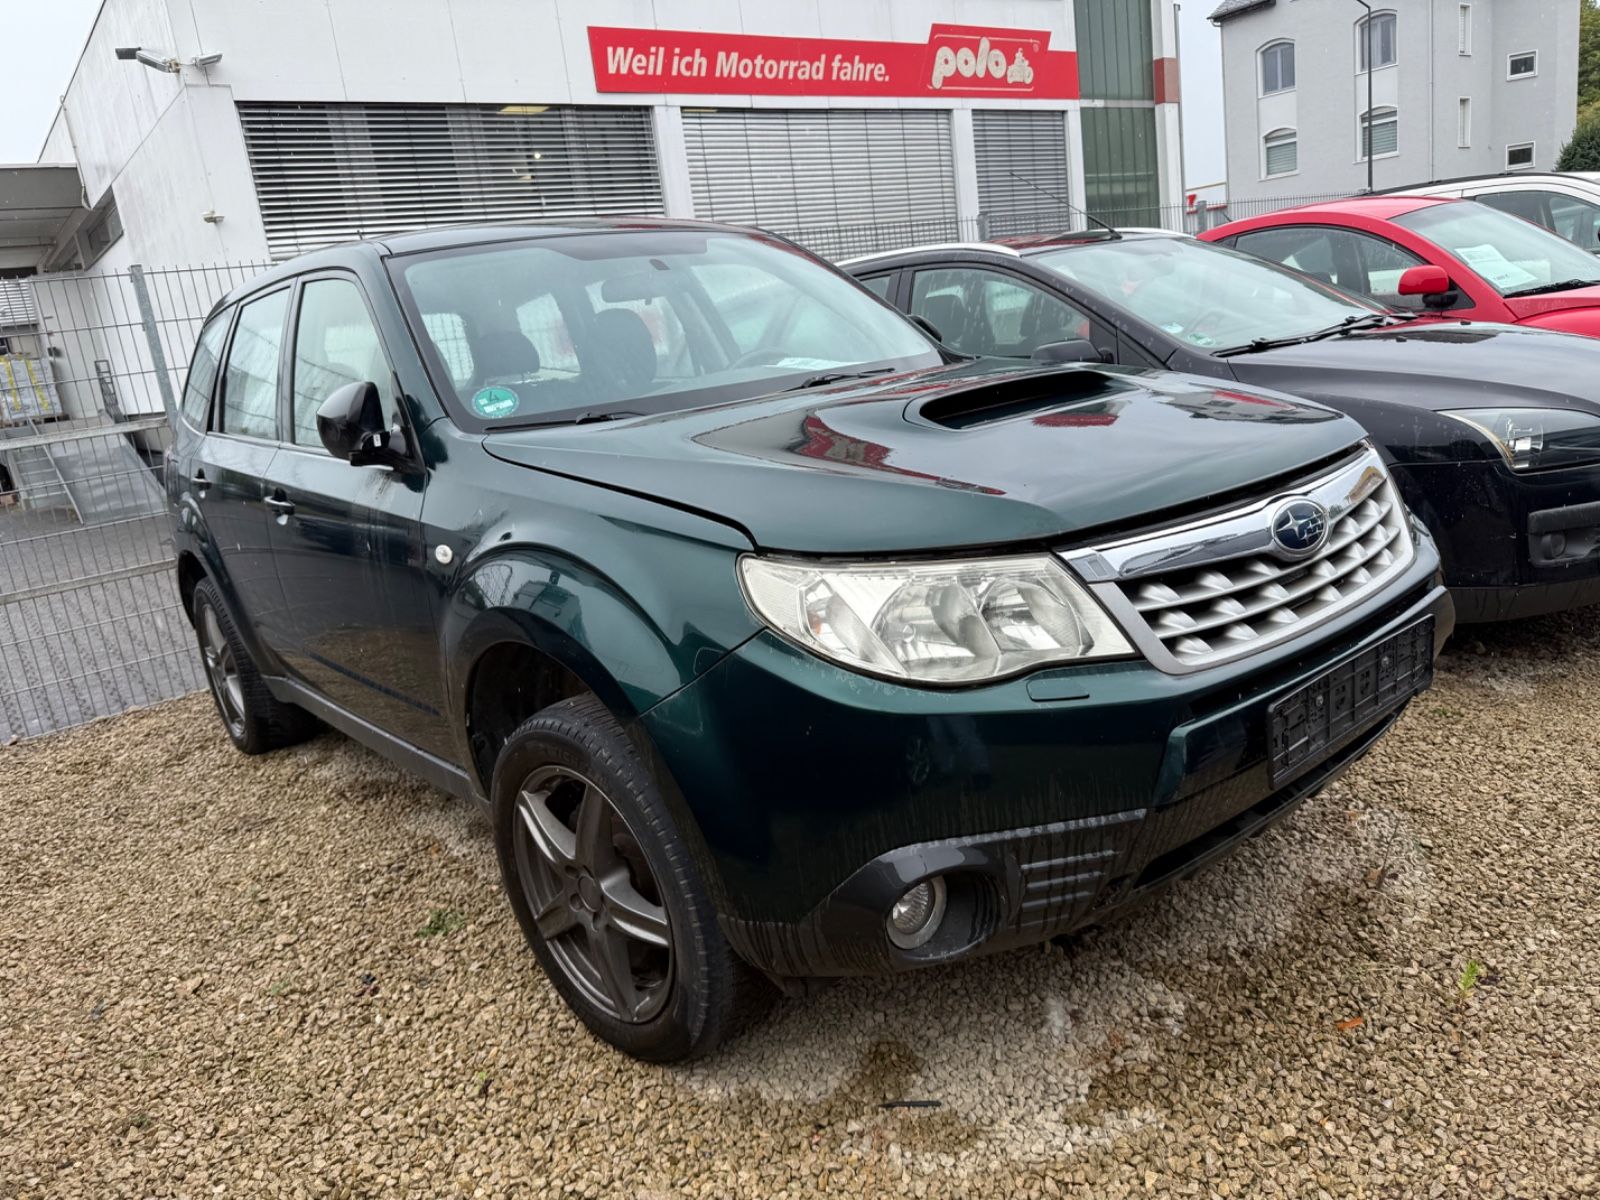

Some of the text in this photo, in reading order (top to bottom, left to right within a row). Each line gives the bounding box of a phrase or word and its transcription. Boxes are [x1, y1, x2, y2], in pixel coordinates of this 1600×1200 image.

[606, 46, 890, 82] Weil ich Motorrad fahre.
[931, 37, 1007, 89] polo
